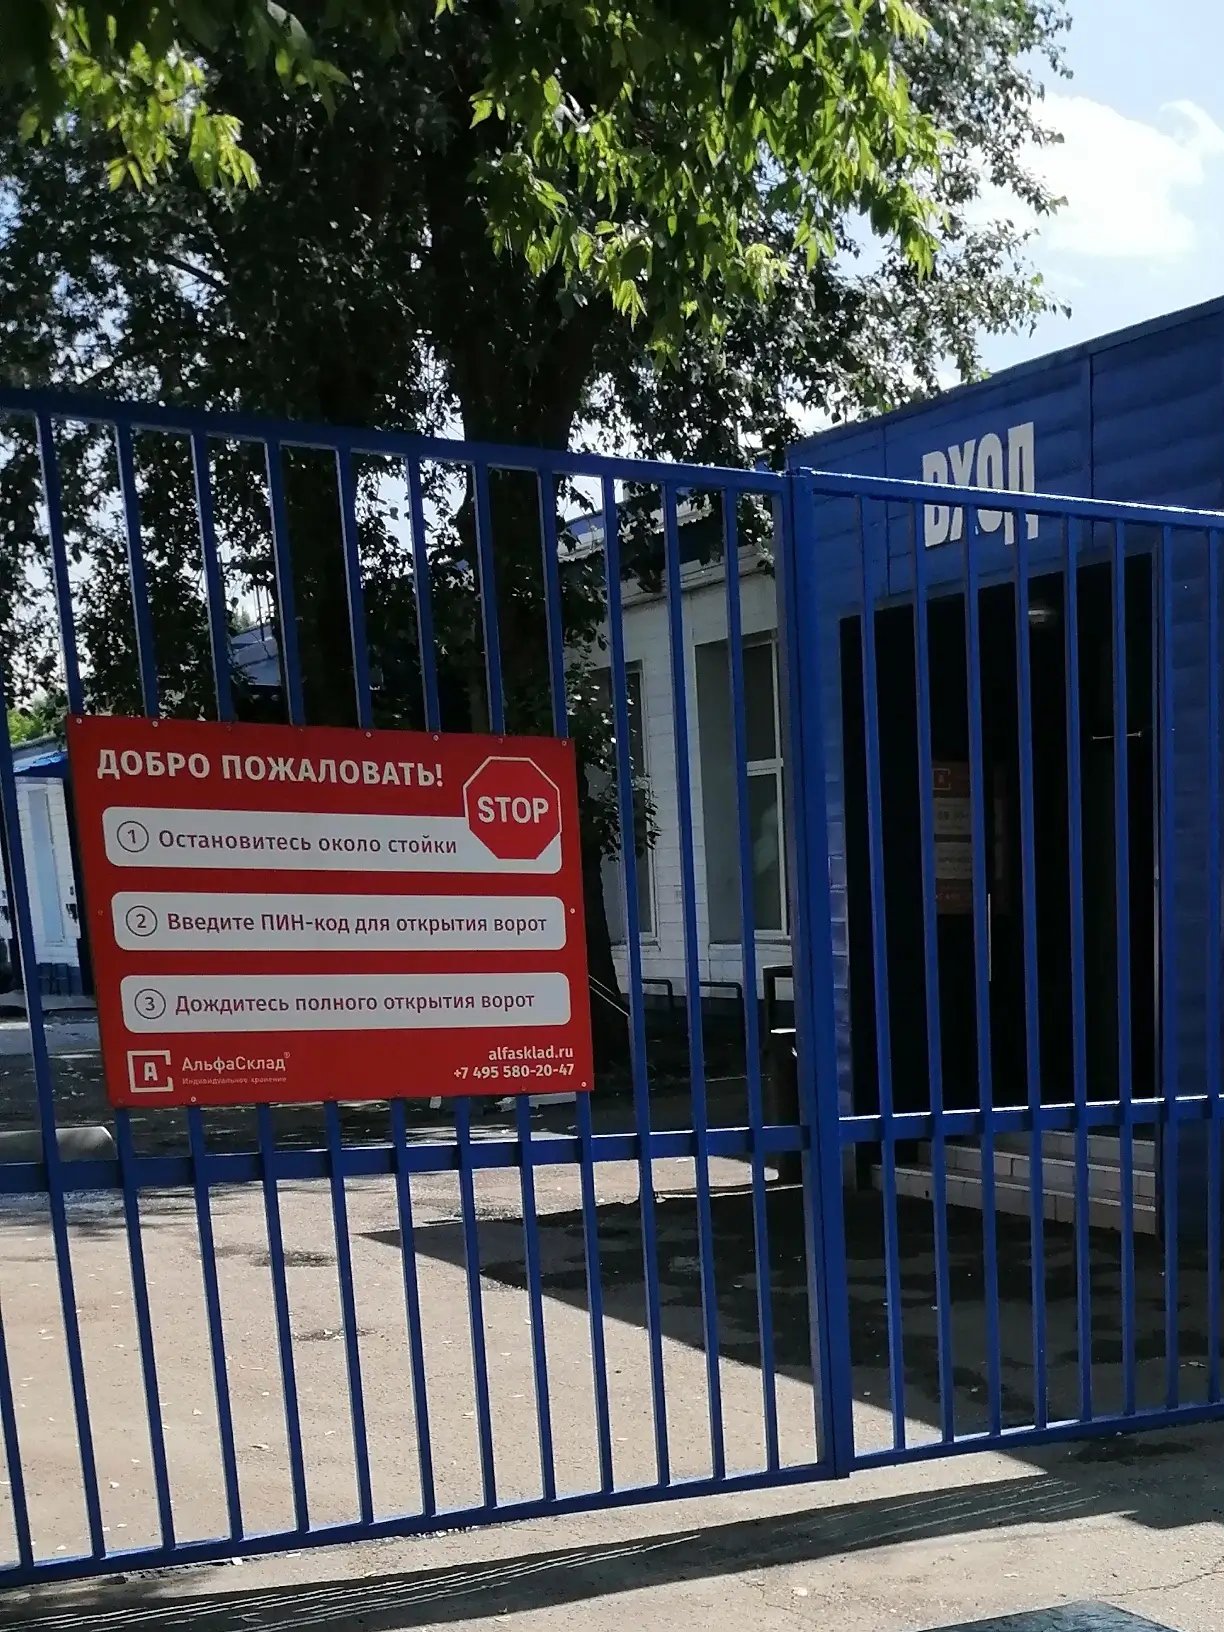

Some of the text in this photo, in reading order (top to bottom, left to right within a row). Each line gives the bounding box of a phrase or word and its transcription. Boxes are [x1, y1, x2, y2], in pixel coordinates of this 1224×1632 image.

[922, 421, 1039, 548] ВХОД
[97, 749, 444, 787] ДОБРО ПОЖАЛОВАТЬ!
[477, 796, 549, 824] STOP
[127, 829, 457, 854] 1 Остановитесь около стойки
[135, 913, 547, 936] 2 Введите ПИН-код для открытия ворот
[144, 994, 535, 1016] 3 Дождитесь полного открытия ворот
[488, 1045, 574, 1060] alfasklad.ru
[453, 1063, 575, 1079] +7 495 580-20-47
